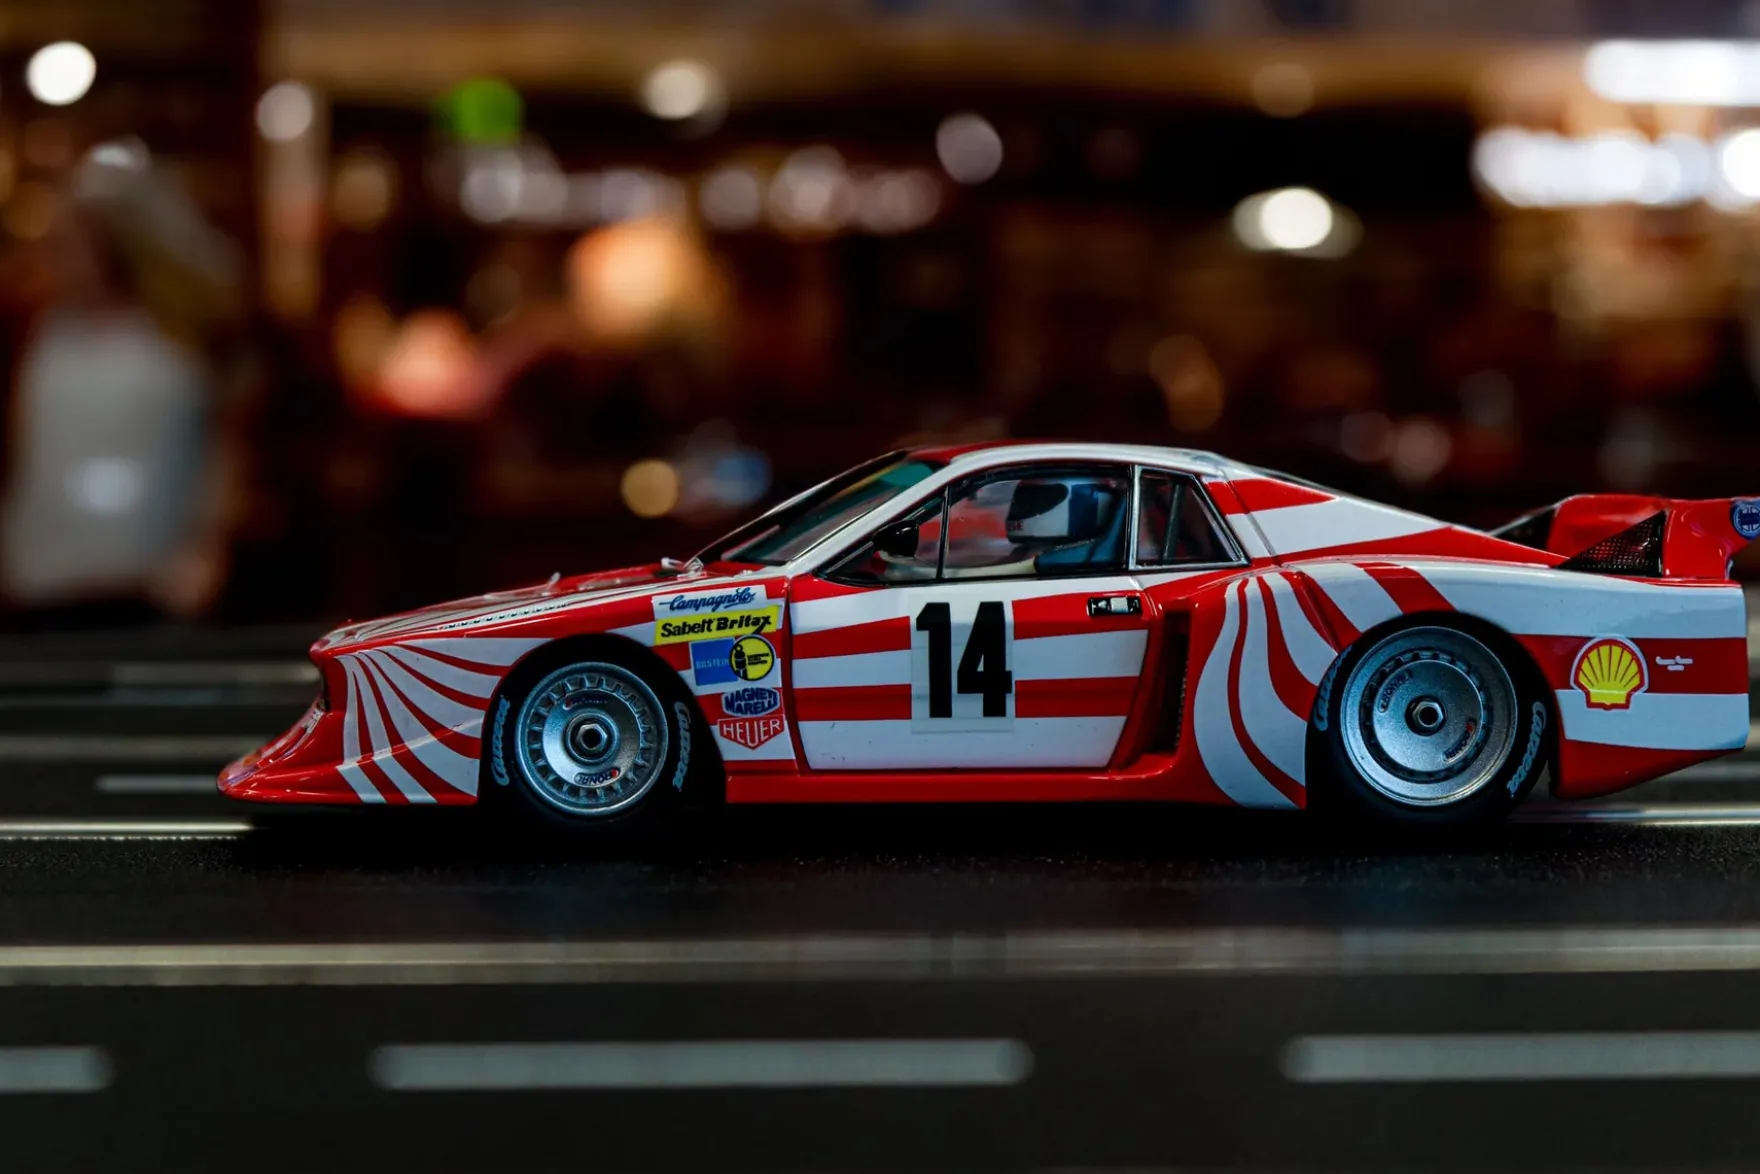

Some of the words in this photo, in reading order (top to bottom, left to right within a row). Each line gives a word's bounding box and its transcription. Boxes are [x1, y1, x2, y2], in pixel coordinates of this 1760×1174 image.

[659, 587, 756, 612] Campagnolo
[661, 618, 713, 637] Sabelt
[716, 615, 772, 634] Britax
[916, 601, 1012, 718] 14
[723, 719, 780, 746] HEUER
